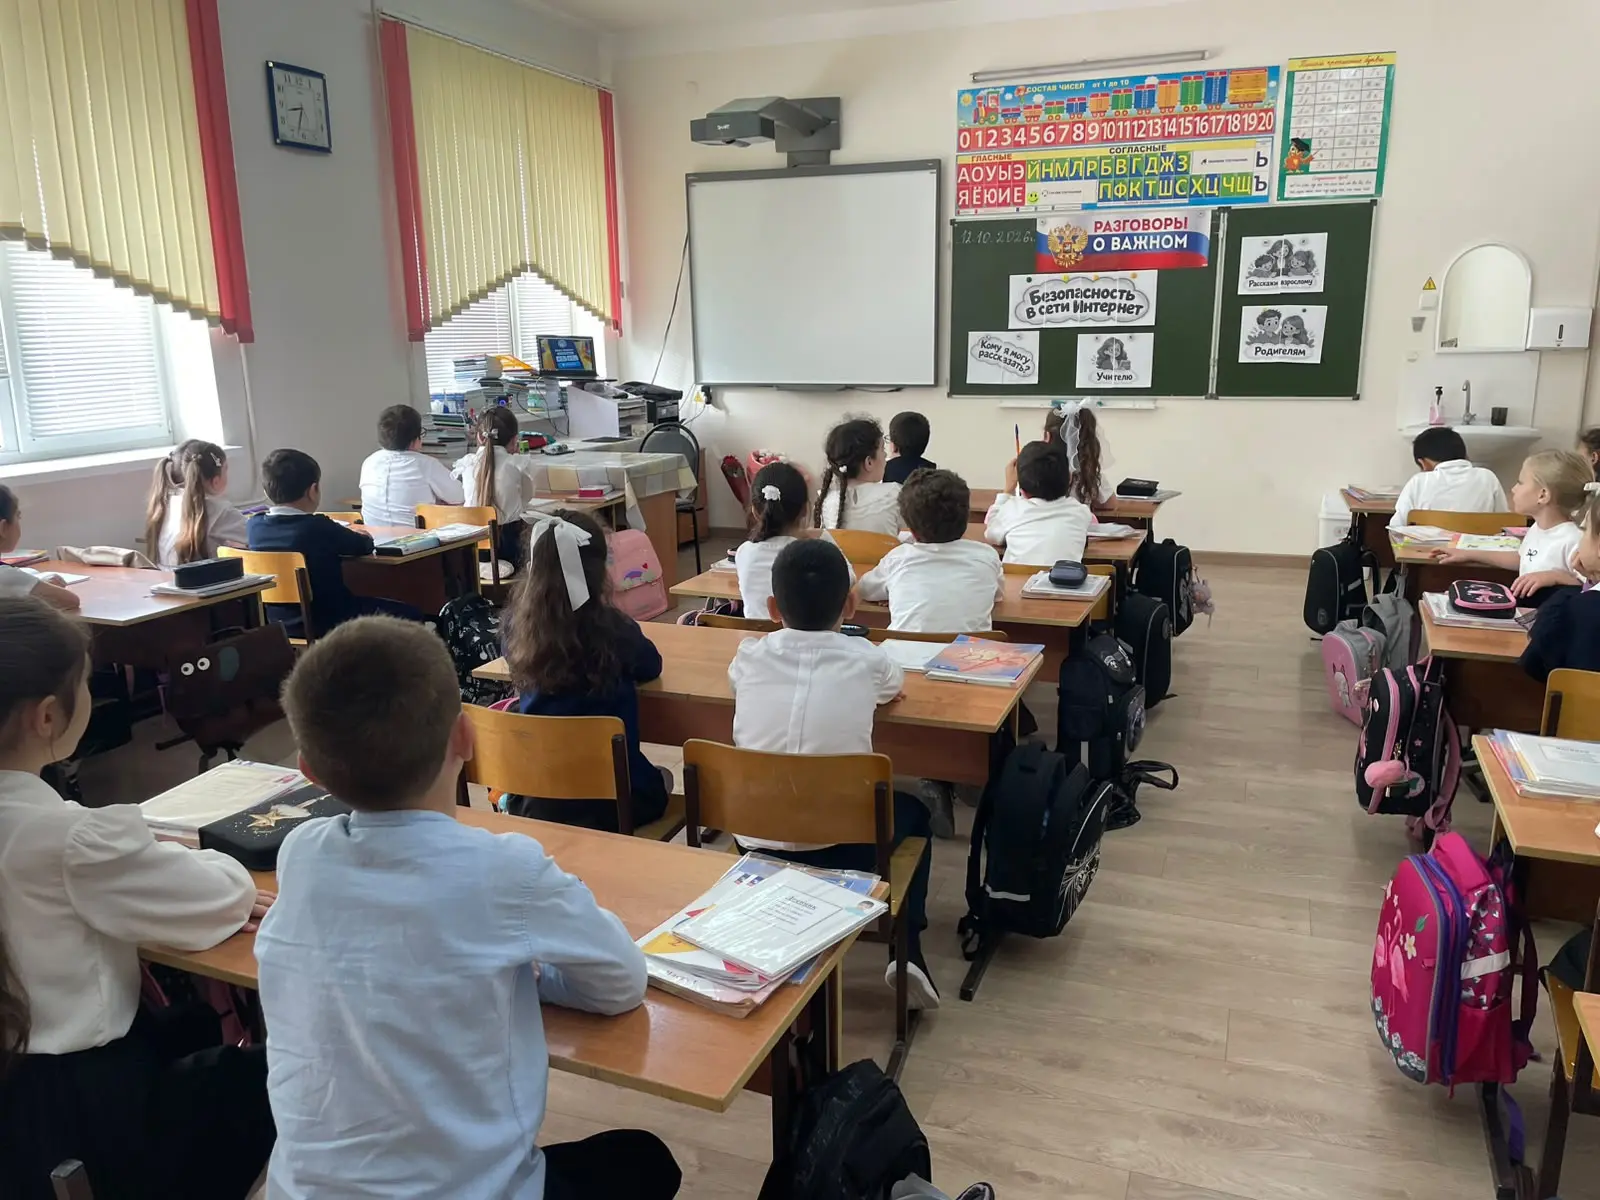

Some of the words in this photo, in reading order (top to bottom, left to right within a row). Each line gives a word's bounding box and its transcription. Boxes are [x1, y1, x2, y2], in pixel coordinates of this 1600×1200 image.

[1027, 84, 1057, 92] СОСТАВ
[1059, 82, 1085, 90] ЧИСЕЛ
[960, 132, 970, 148] 0
[976, 130, 982, 148] 1
[986, 129, 998, 147] 2
[1000, 128, 1012, 146] 3
[1014, 127, 1026, 145] 4
[1030, 126, 1040, 144] 5
[1043, 126, 1056, 143] 6
[1058, 124, 1070, 142] 7
[1072, 124, 1084, 142] 8
[1088, 122, 1100, 141] 9
[1102, 122, 1116, 140] 10
[1118, 121, 1130, 138] 11
[1132, 120, 1146, 138] 12
[1148, 119, 1161, 137] 13
[1162, 118, 1176, 136] 14
[1178, 116, 1192, 135] 15
[1194, 116, 1208, 134] 16
[1210, 115, 1225, 133] 17
[1226, 114, 1240, 132] 18
[1242, 112, 1257, 131] 19
[1258, 112, 1274, 130] 20
[1109, 144, 1167, 154] СОГЛАСНЫЕ
[972, 154, 1012, 162] ГЛАСНЫЕ
[1094, 217, 1188, 233] РАЗГОВОРЫ
[1093, 238, 1105, 252] О
[1111, 234, 1188, 250] ВАЖНОМ
[1028, 288, 1136, 306] Безопасность
[1038, 302, 1070, 315] сети
[1073, 300, 1144, 316] Интернет
[980, 340, 1002, 352] Кому
[1010, 350, 1031, 364] могу
[978, 350, 1031, 374] рассказать?
